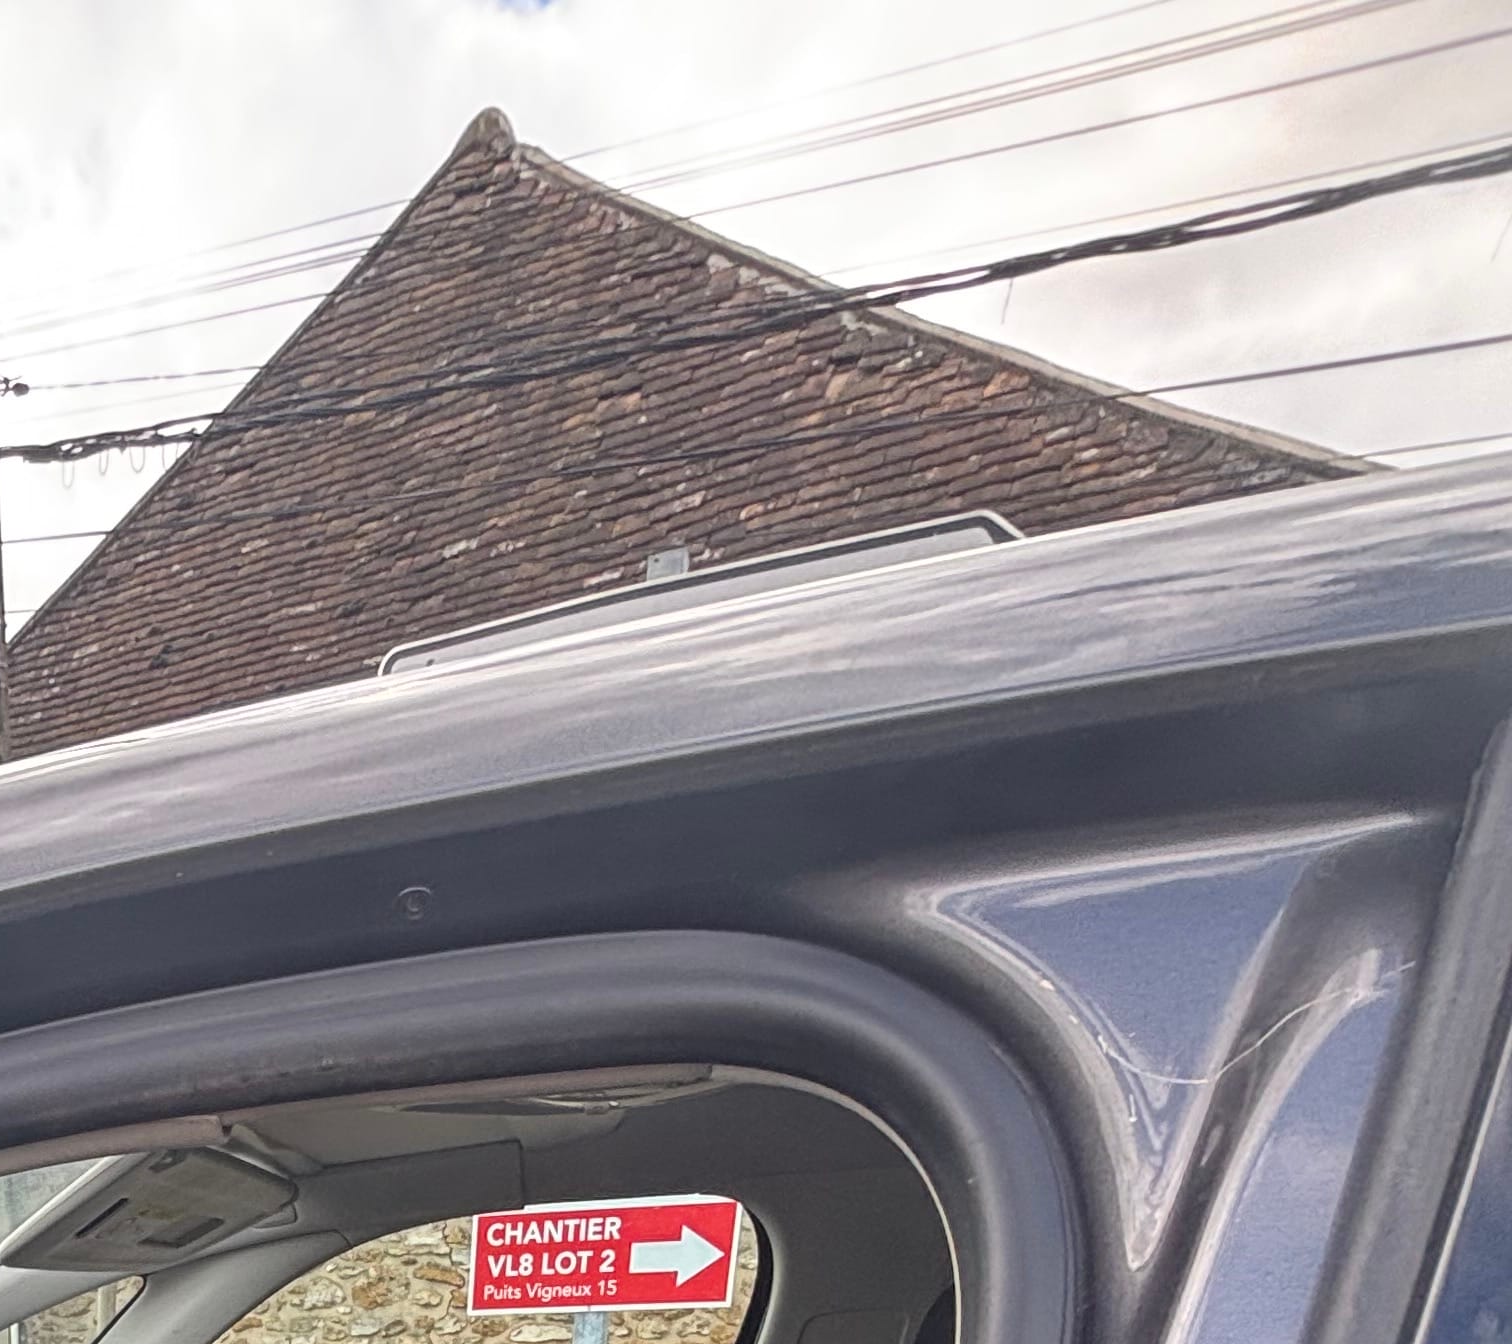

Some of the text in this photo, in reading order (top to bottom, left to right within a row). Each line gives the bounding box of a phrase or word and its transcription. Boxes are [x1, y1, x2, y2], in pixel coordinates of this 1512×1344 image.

[487, 1216, 622, 1247] CHANTIER
[488, 1250, 616, 1278] VL8 LOT 2
[484, 1280, 618, 1302] Puits Vigneux 15
